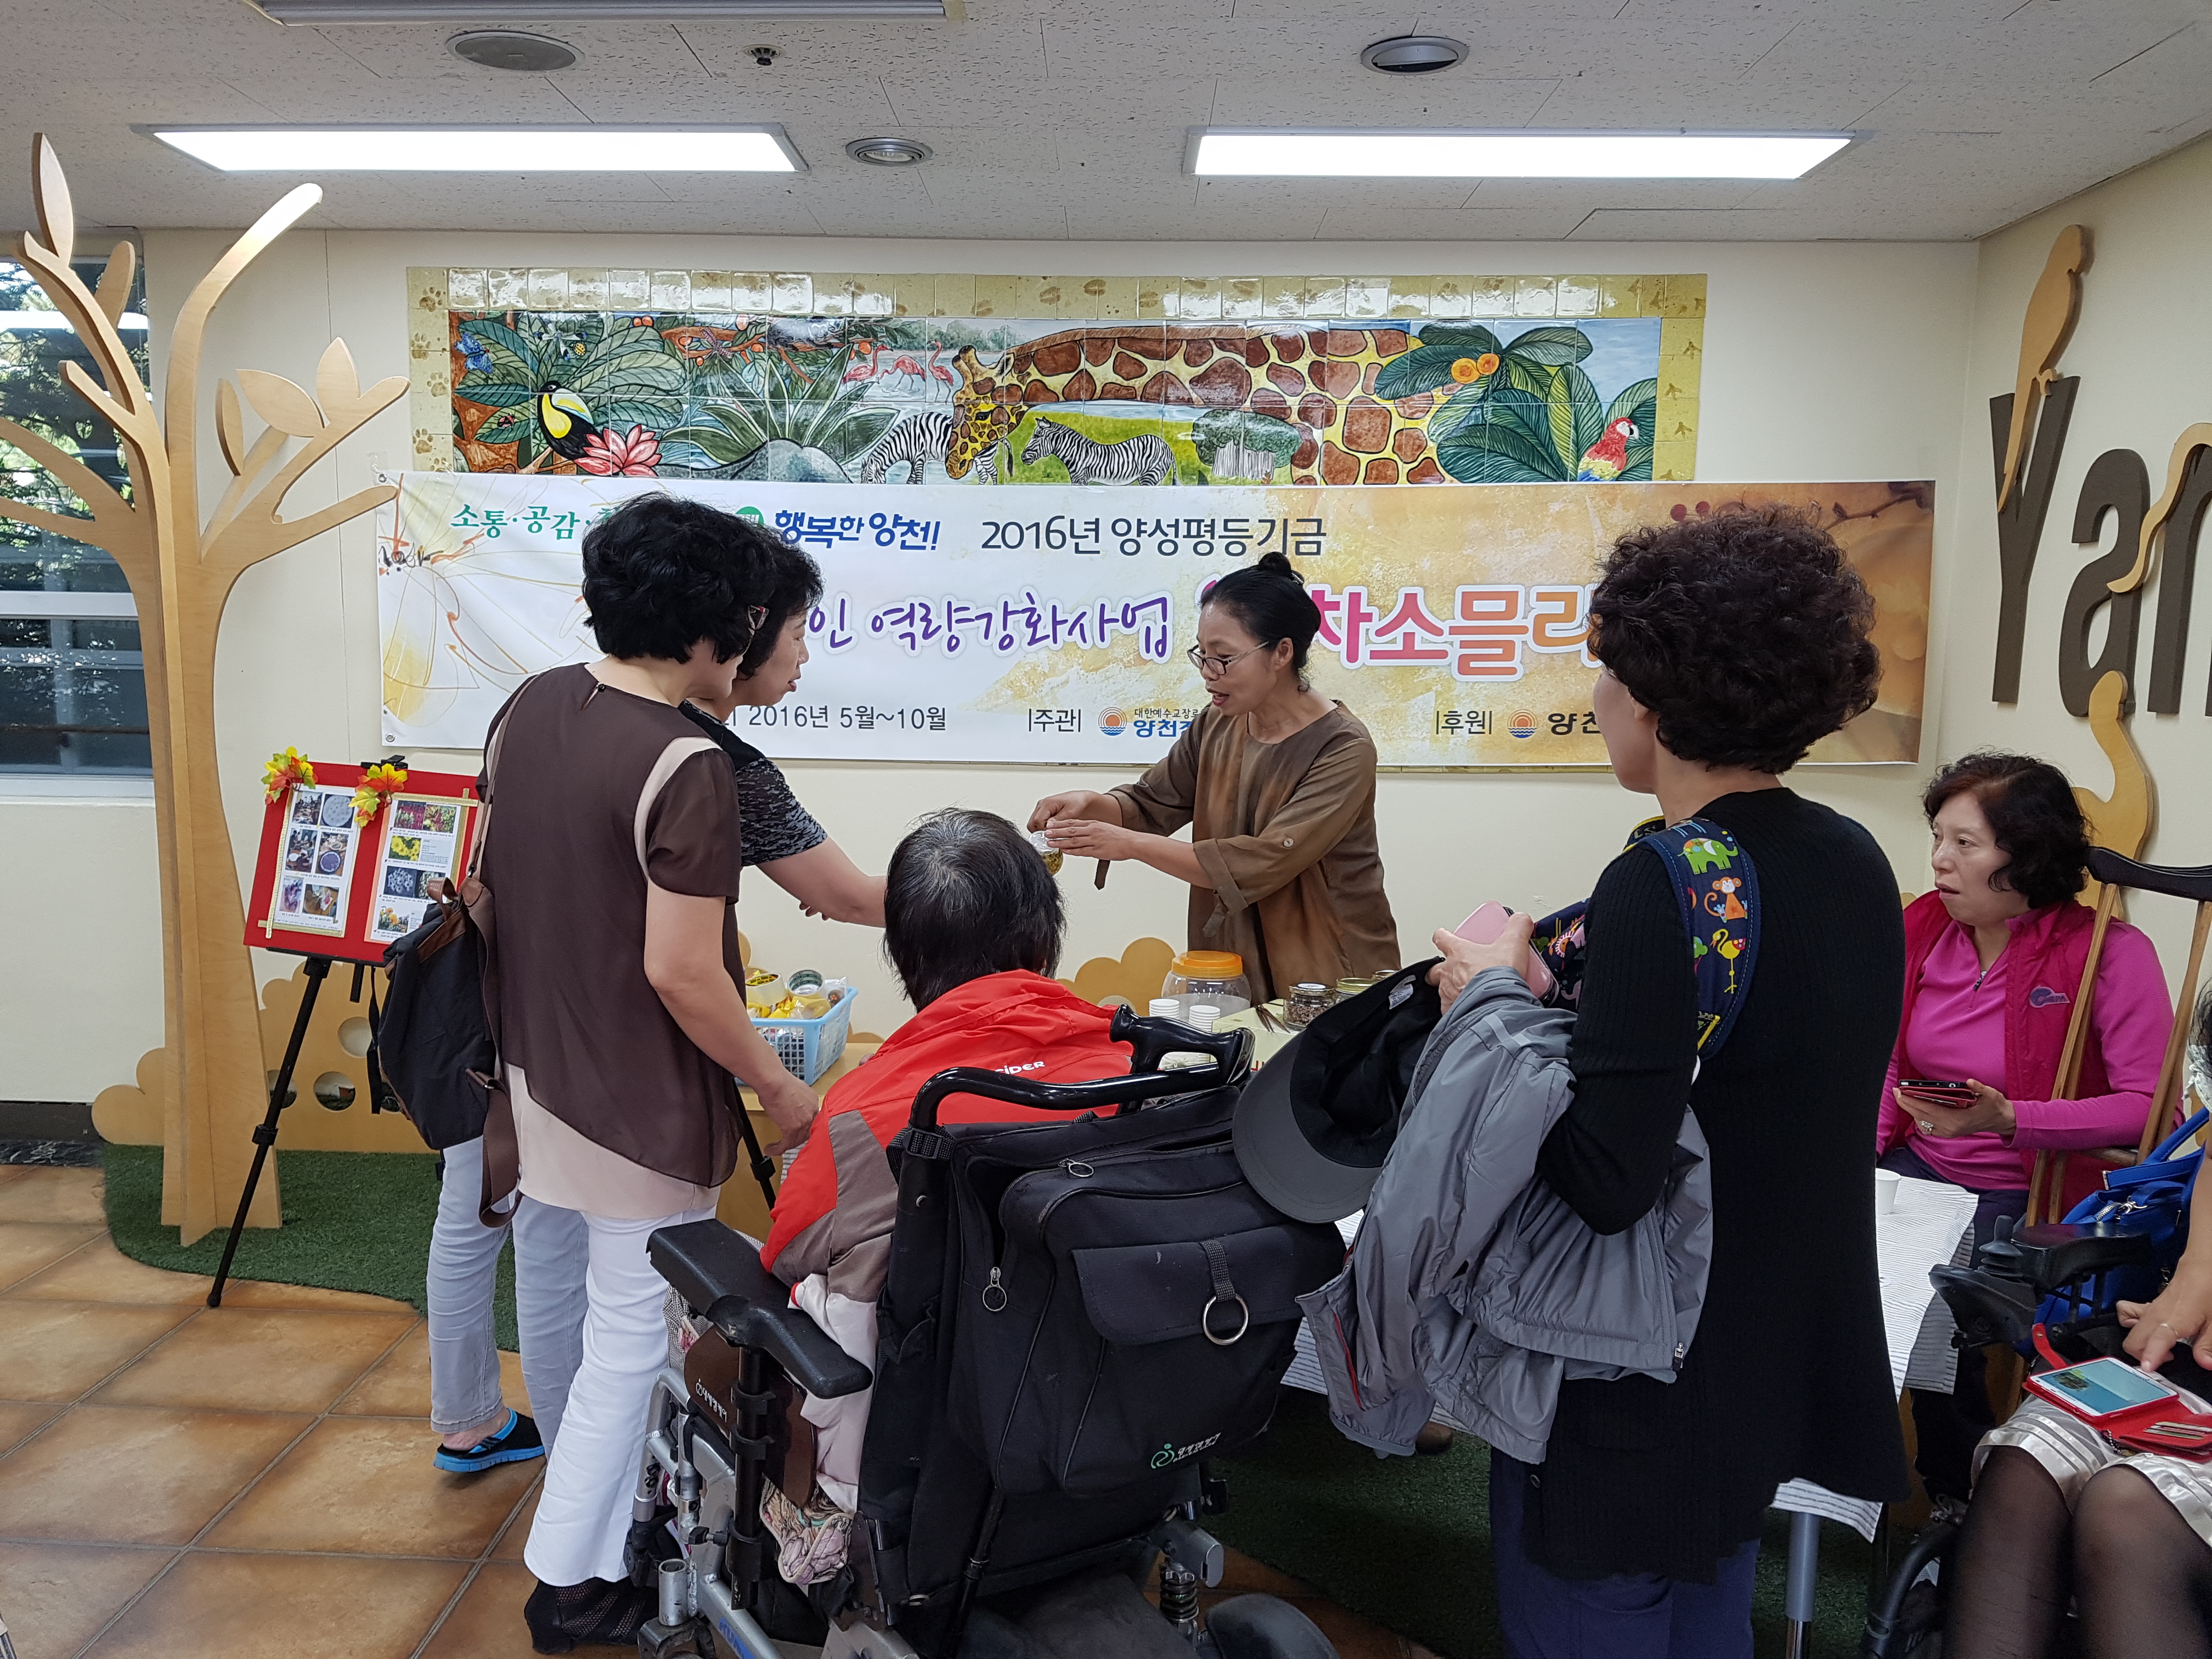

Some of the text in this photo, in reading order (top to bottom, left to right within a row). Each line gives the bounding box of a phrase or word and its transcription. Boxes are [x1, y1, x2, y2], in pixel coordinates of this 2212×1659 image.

[775, 510, 941, 550] 행복한 양천!
[981, 515, 1327, 556] 2016년 양성평등기금
[871, 591, 1168, 658] 역량강화사업
[1202, 579, 1603, 676] 차소믈리
[749, 706, 829, 729] 2016년
[840, 706, 946, 731] 5월~10월
[1135, 708, 1209, 719] 대한예수교장로
